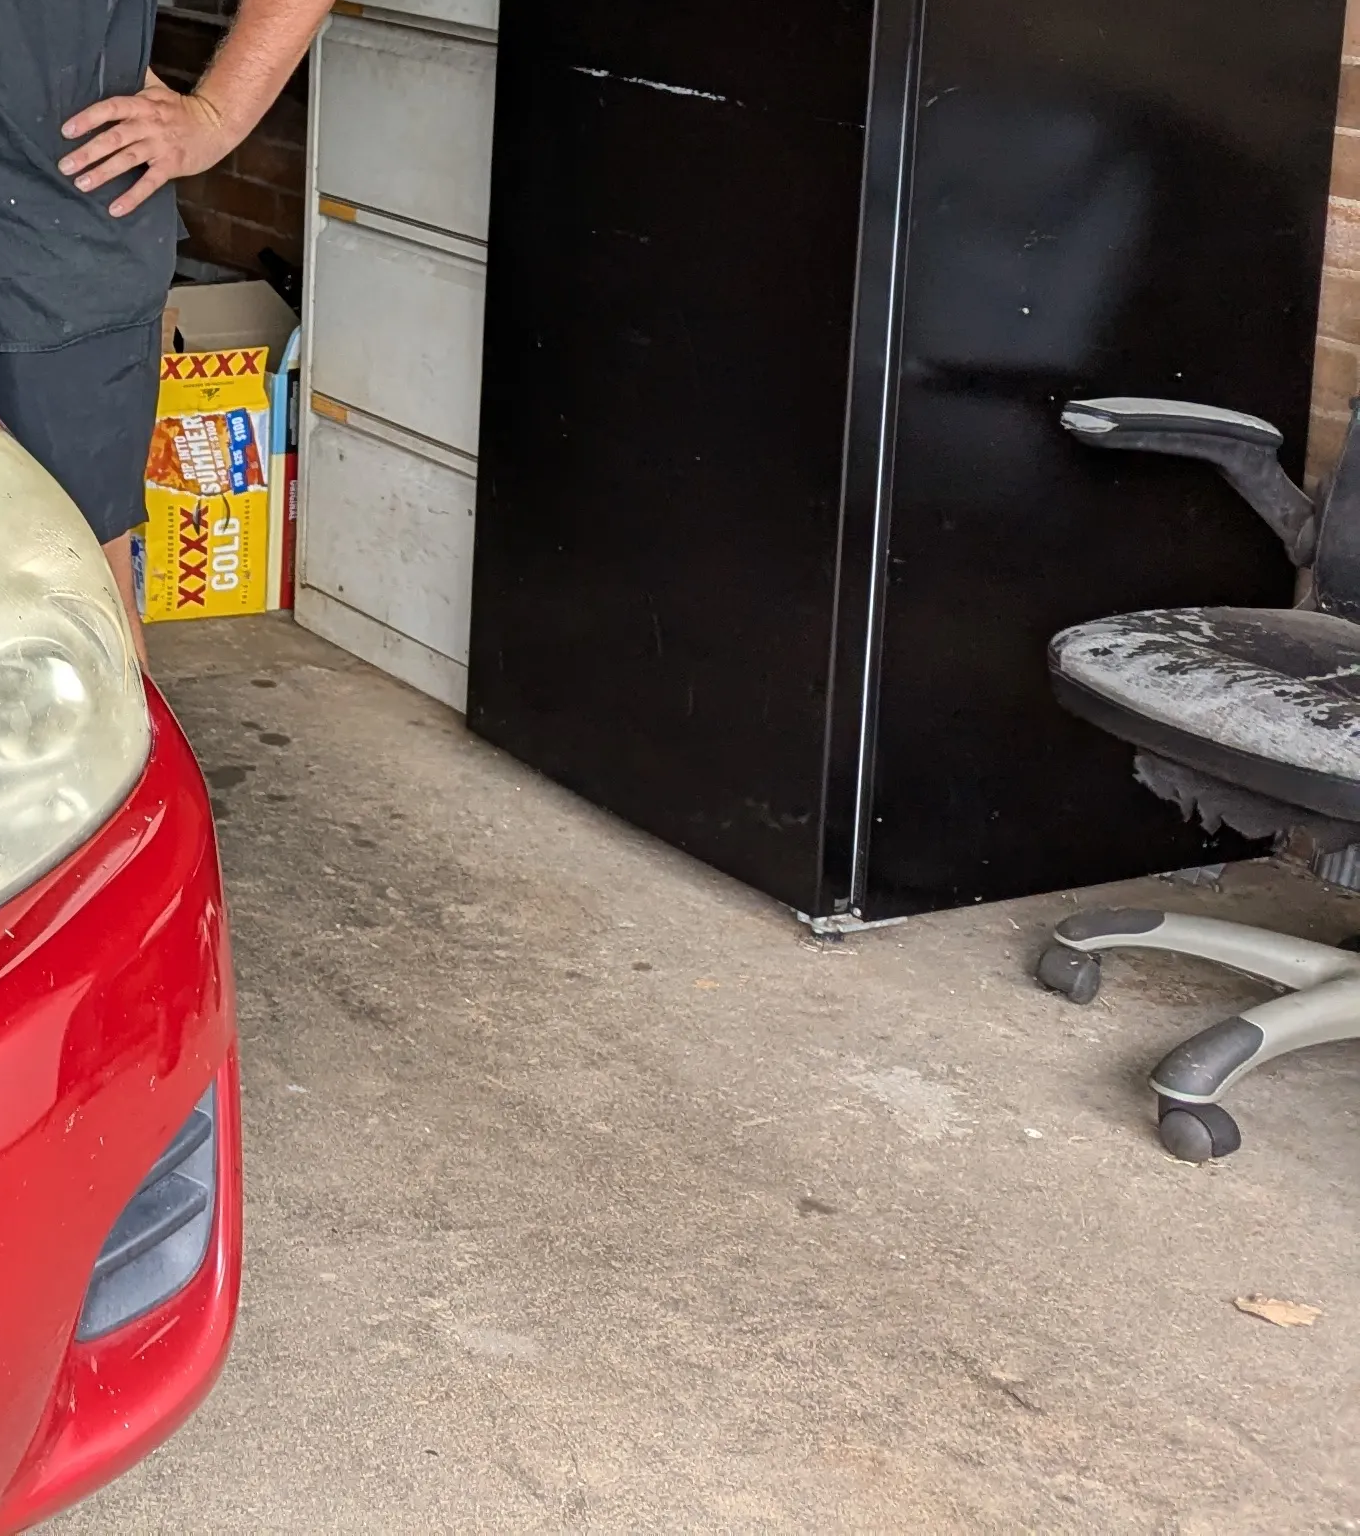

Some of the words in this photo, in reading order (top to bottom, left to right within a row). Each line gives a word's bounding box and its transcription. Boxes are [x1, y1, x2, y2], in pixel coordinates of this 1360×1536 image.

[160, 350, 263, 380] XXXX
[231, 417, 247, 442] $100
[174, 435, 191, 460] INTO
[181, 415, 221, 494] SUMMER
[213, 450, 225, 468] WIN
[233, 450, 243, 465] $25
[181, 462, 196, 480] RIP
[177, 505, 209, 609] XXXX
[211, 517, 240, 591] GOLD
